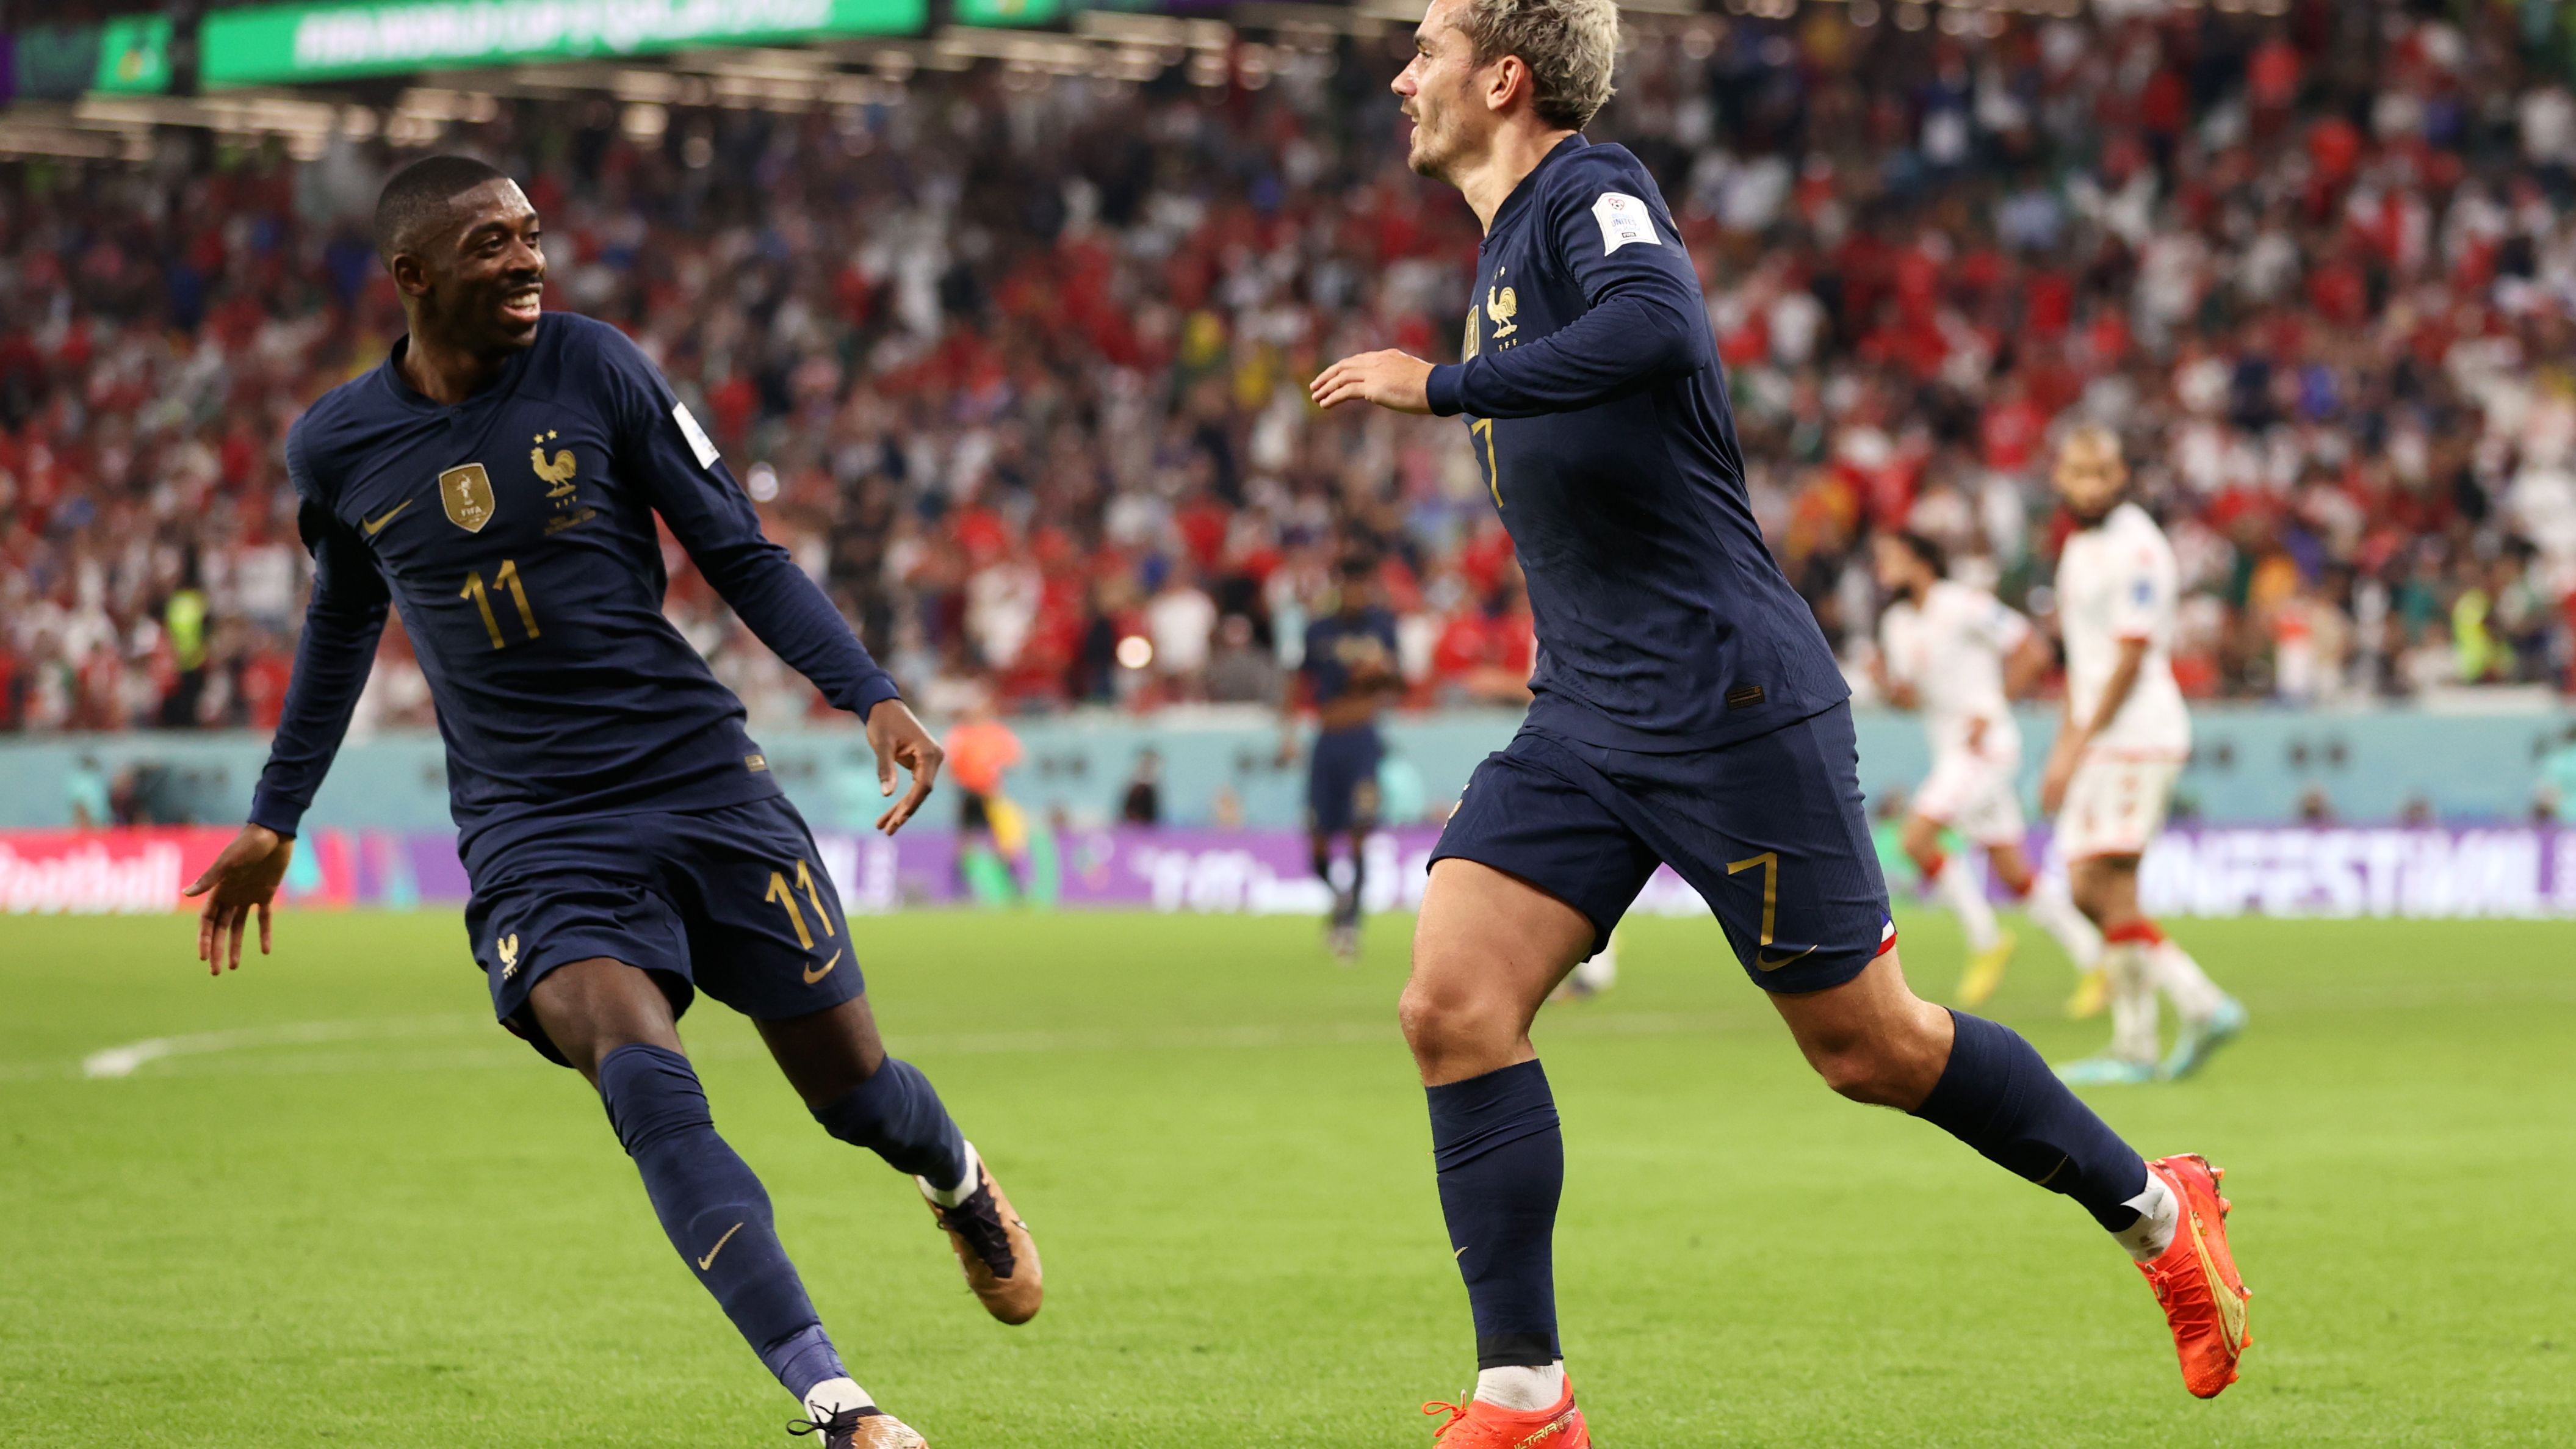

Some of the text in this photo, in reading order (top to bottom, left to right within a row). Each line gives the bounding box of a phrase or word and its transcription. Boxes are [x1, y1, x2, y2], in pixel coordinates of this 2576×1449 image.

[1471, 417, 1504, 508] 7
[460, 558, 540, 649] 11
[764, 859, 835, 950] 11
[1726, 851, 1778, 946] 7
